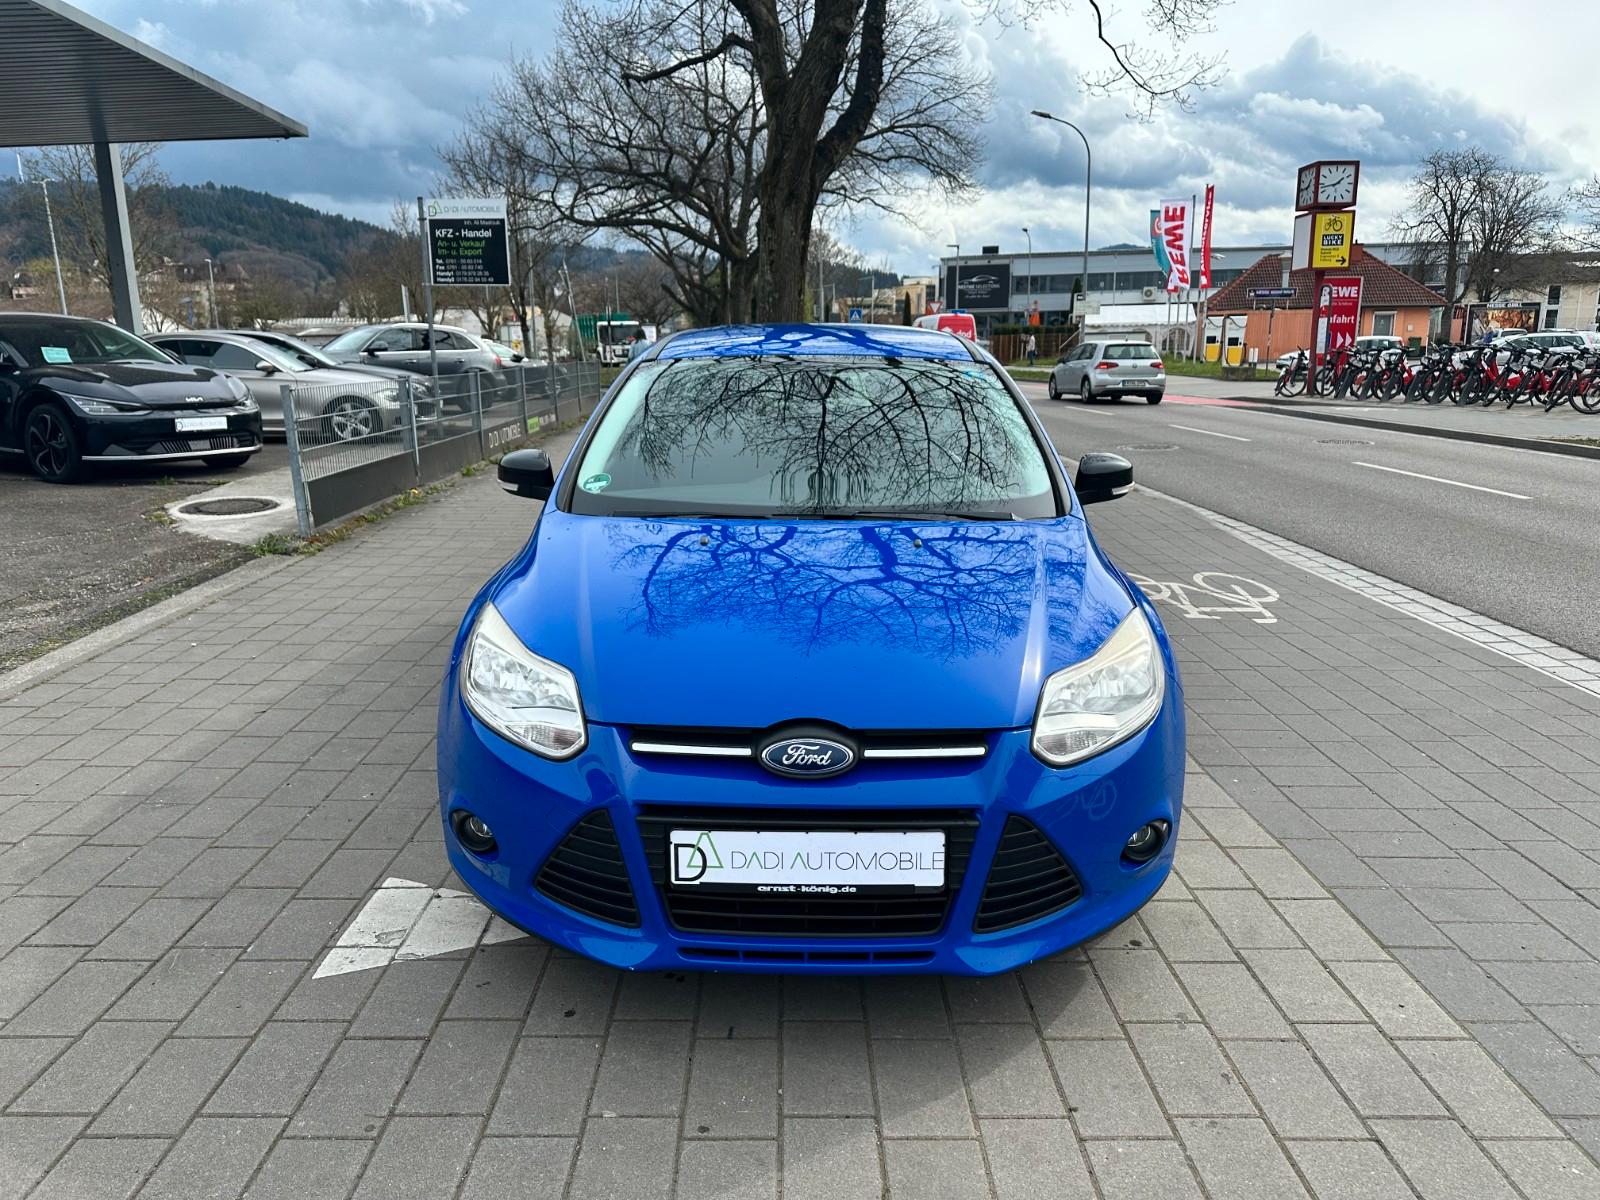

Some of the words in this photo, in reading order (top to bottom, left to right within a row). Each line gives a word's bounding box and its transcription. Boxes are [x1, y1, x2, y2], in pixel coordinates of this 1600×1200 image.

[436, 229, 453, 238] KFZ
[461, 229, 492, 238] Handel
[782, 744, 833, 766] Ford
[732, 851, 783, 870] DADI
[790, 851, 945, 870] AUTOMOBILE
